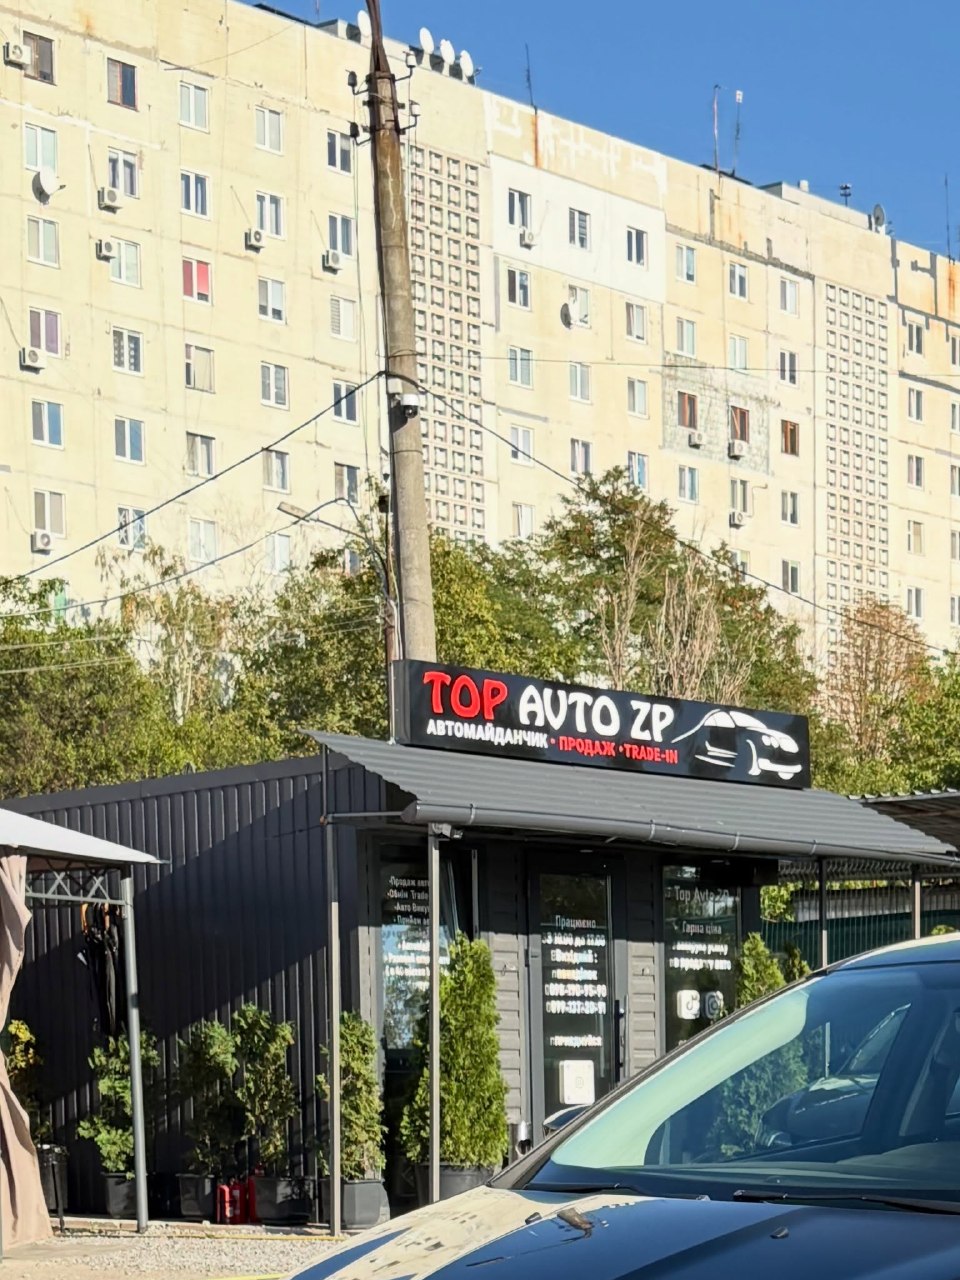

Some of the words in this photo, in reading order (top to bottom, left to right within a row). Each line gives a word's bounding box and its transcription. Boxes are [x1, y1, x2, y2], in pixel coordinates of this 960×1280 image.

[423, 671, 508, 720] TOP
[518, 684, 620, 736] AVTO
[630, 700, 674, 742] ZP
[426, 719, 549, 749] АВТОМАЙДАНЧИК
[559, 736, 615, 757] ПРОДАЖ
[624, 743, 678, 764] TRADE-IN
[674, 885, 691, 905] Top
